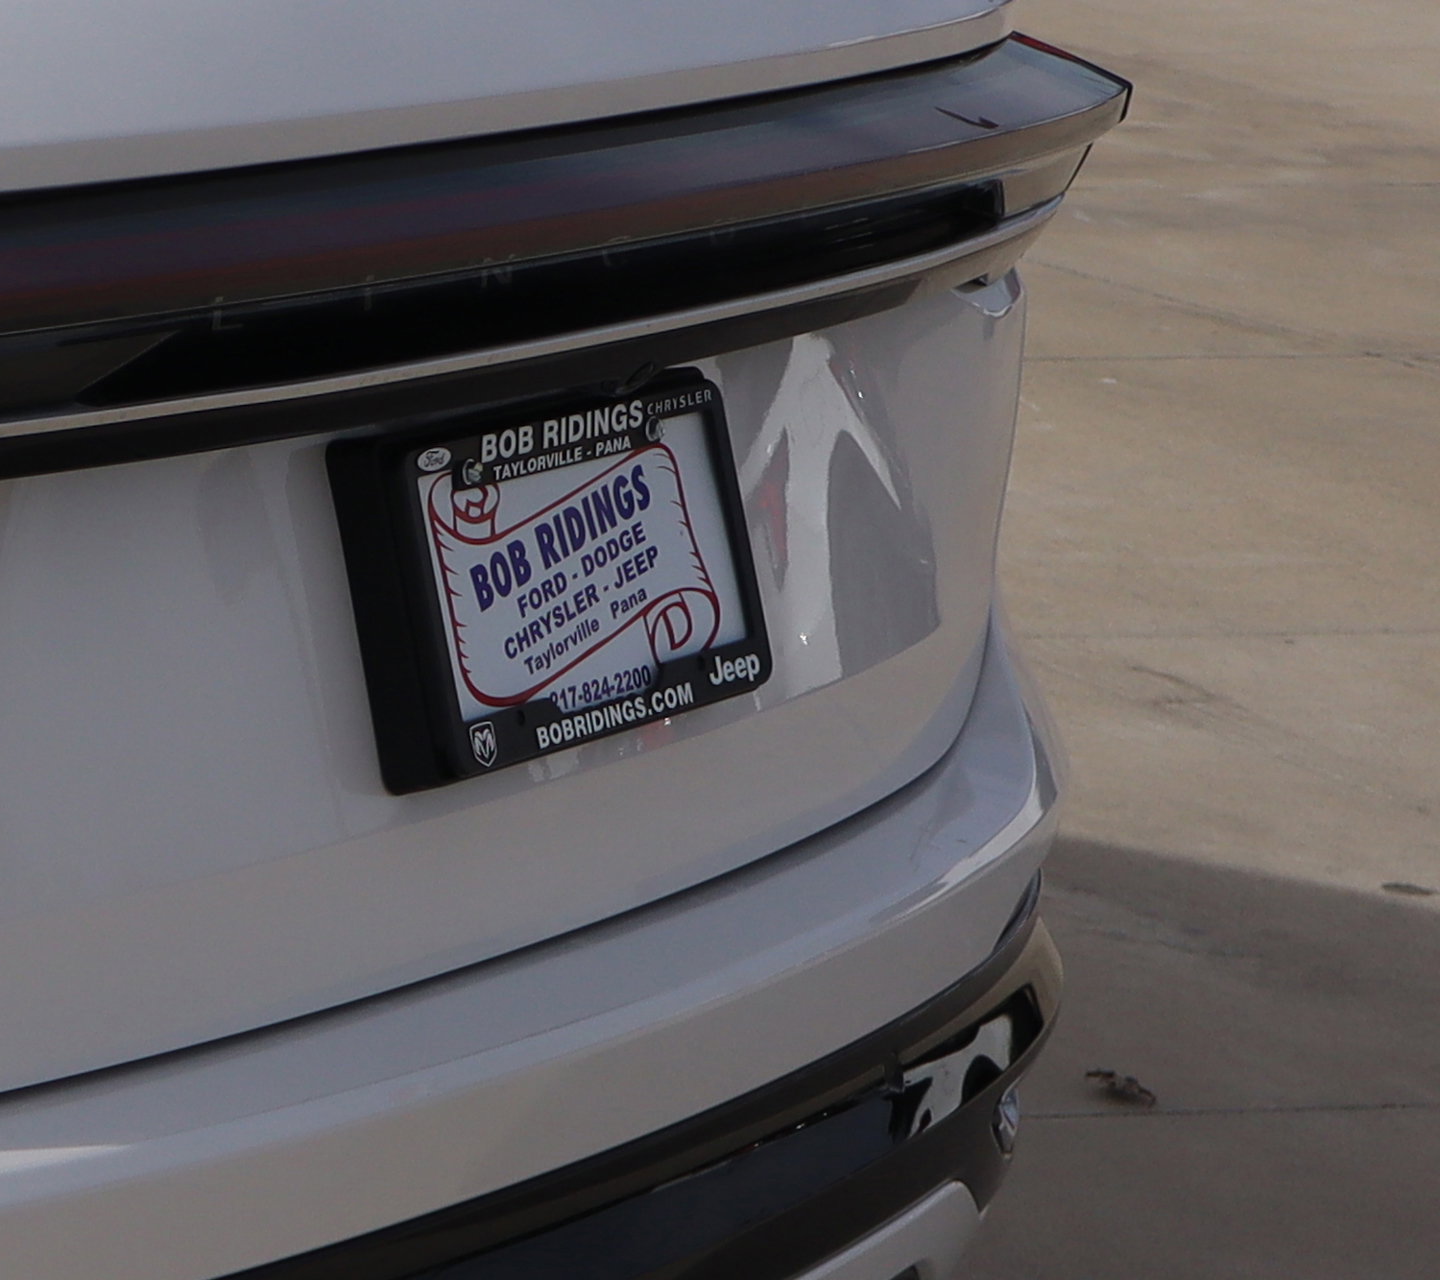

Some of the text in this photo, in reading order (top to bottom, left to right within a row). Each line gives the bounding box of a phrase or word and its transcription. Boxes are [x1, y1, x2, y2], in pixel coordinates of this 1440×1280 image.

[481, 400, 644, 463] BOB RIDINGS
[647, 389, 712, 416] CHRYSLER
[493, 446, 583, 481] TAYLORVILLE
[596, 436, 631, 459] PANA
[469, 464, 651, 613] BOB RIDINGS
[517, 571, 567, 619] FORD
[580, 521, 647, 578] DODGE
[504, 583, 601, 660] CHRYSLER
[614, 545, 659, 590] JEEP
[523, 588, 648, 676] Taylorville Pana
[709, 653, 761, 686] Jeep
[536, 682, 694, 749] BOBRIDINGS.COM
